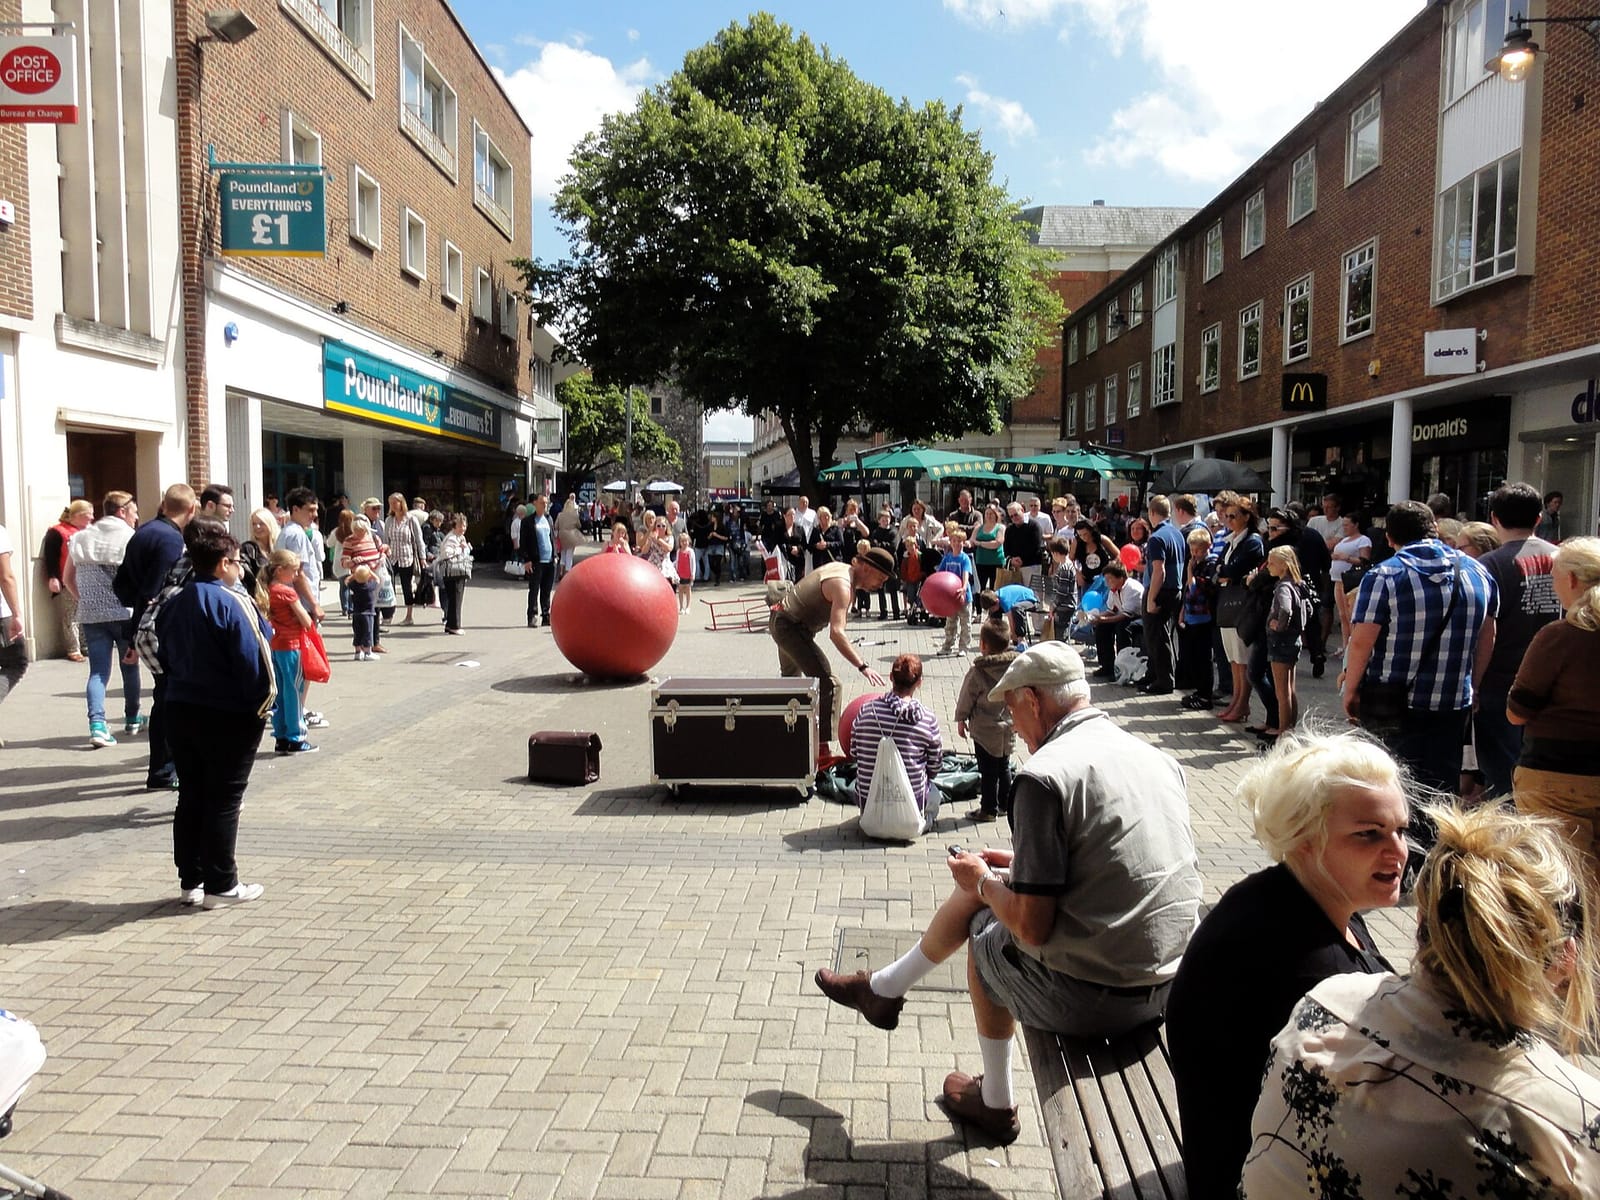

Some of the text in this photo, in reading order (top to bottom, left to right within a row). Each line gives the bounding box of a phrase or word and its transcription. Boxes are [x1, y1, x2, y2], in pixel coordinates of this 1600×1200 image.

[13, 55, 49, 69] POST
[5, 69, 54, 83] OFFICE
[0, 109, 63, 120] Bureau de Change
[229, 180, 297, 194] Poundland
[231, 198, 313, 213] EVERYTHING'S
[251, 213, 289, 245] £1
[344, 356, 424, 417] Poundland
[484, 409, 494, 436] £1
[1412, 416, 1468, 442] Donald's
[711, 458, 734, 466] ODEON
